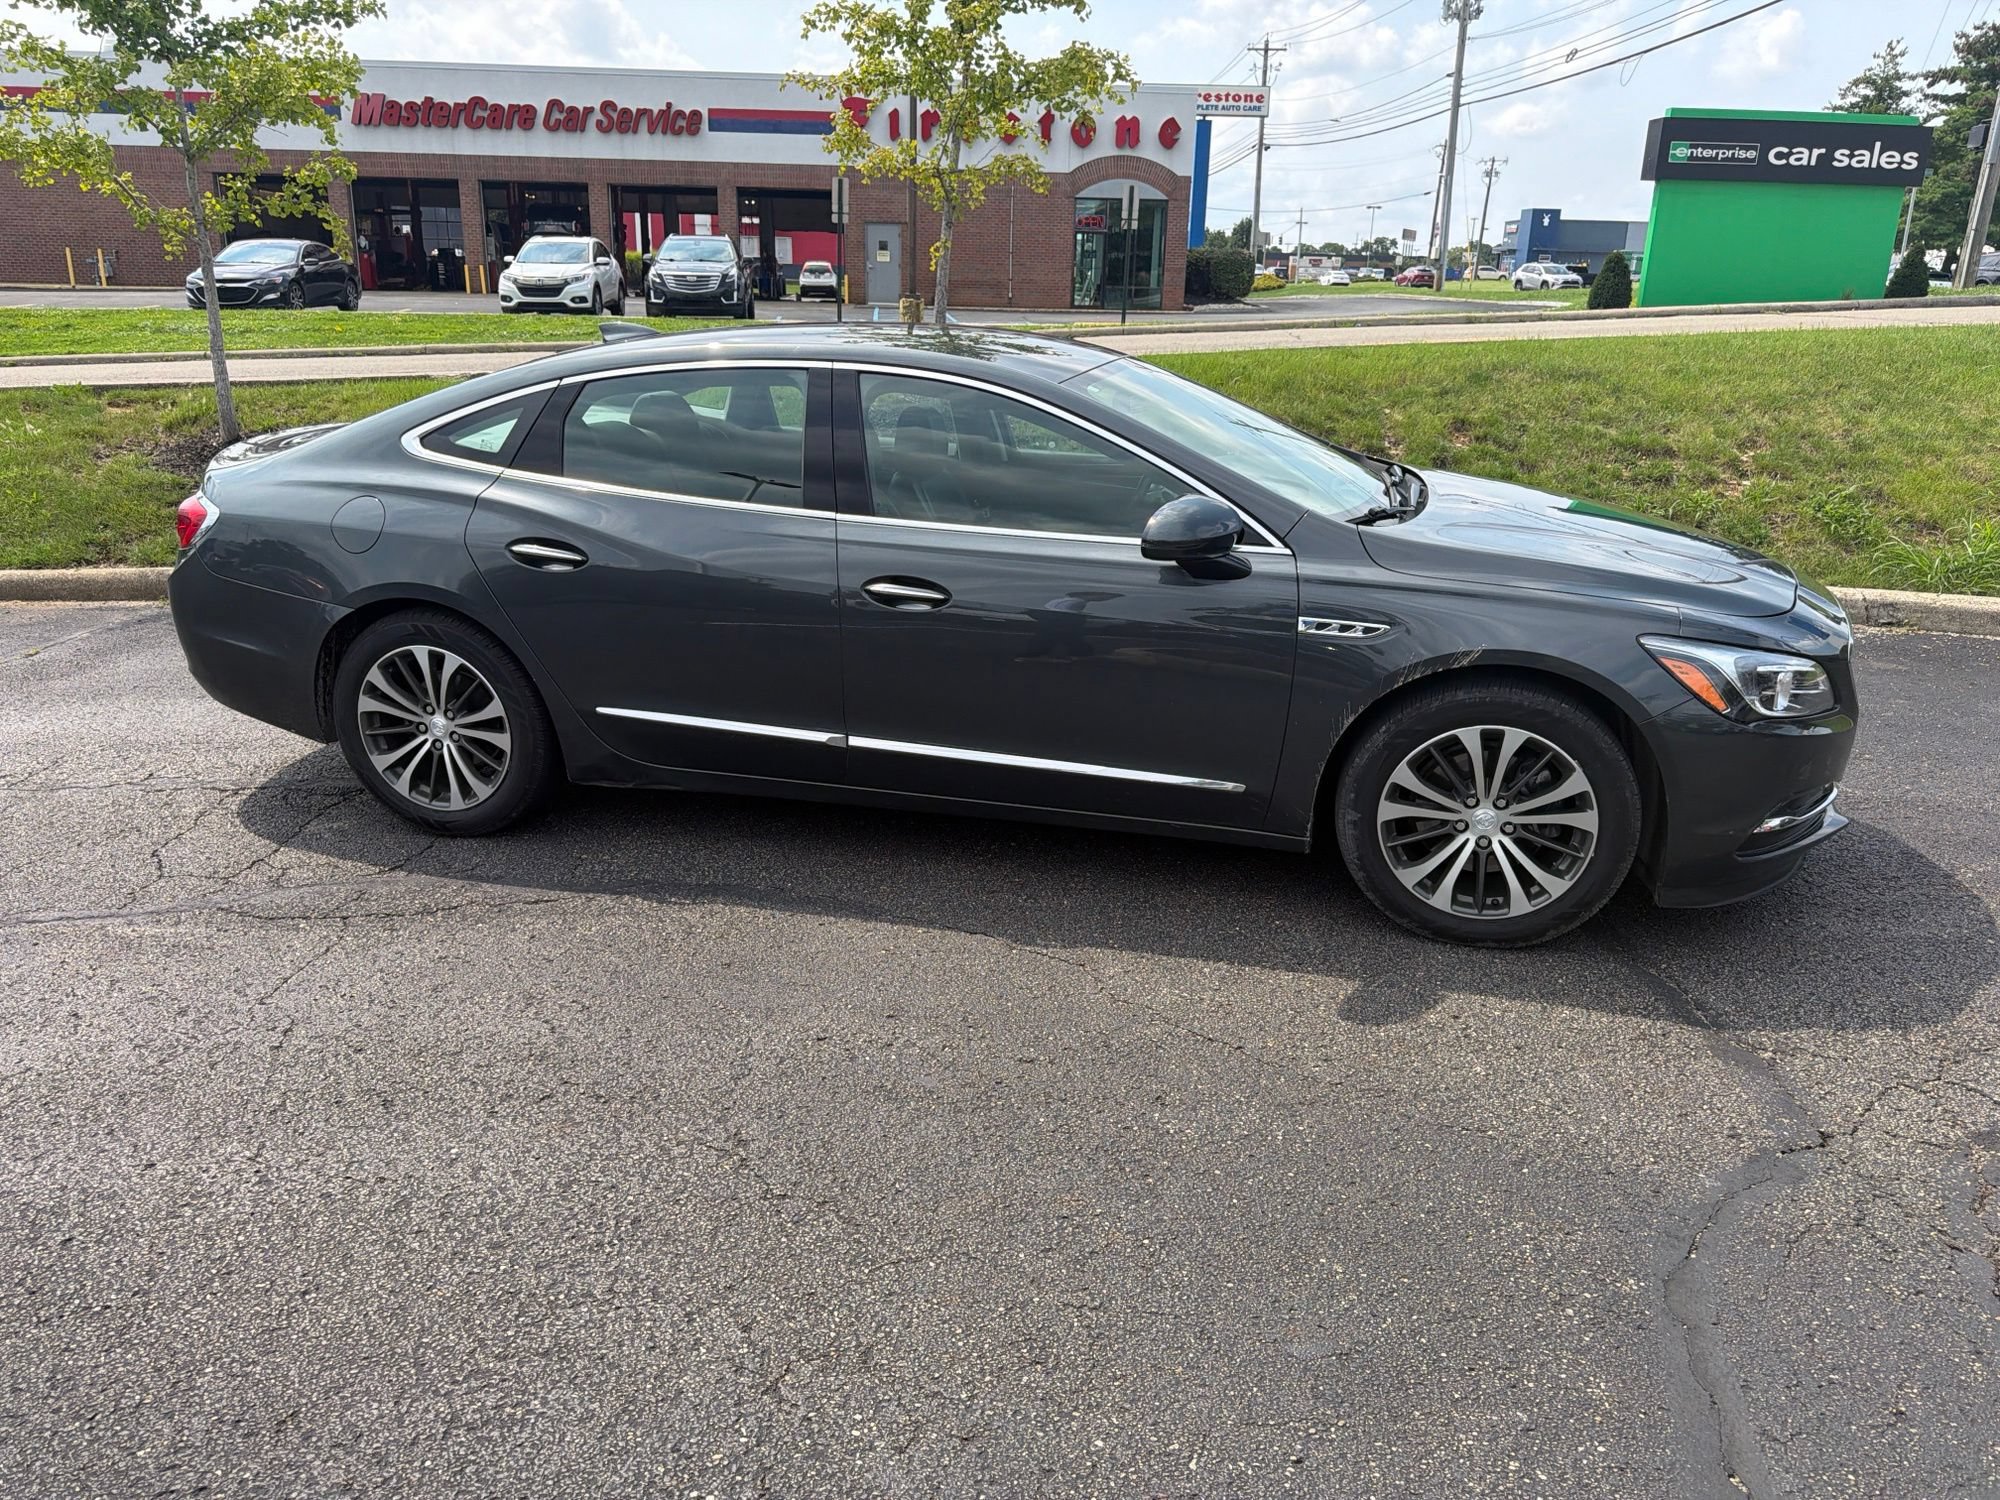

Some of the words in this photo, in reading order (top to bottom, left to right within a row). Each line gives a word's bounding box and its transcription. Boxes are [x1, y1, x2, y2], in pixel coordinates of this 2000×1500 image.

[351, 92, 538, 131] MasterCare
[543, 98, 595, 133] Car
[595, 99, 703, 136] Service
[1221, 104, 1241, 112] AUTO
[1673, 146, 1757, 161] enterprise
[1767, 146, 1826, 167] car
[1832, 141, 1920, 171] sales
